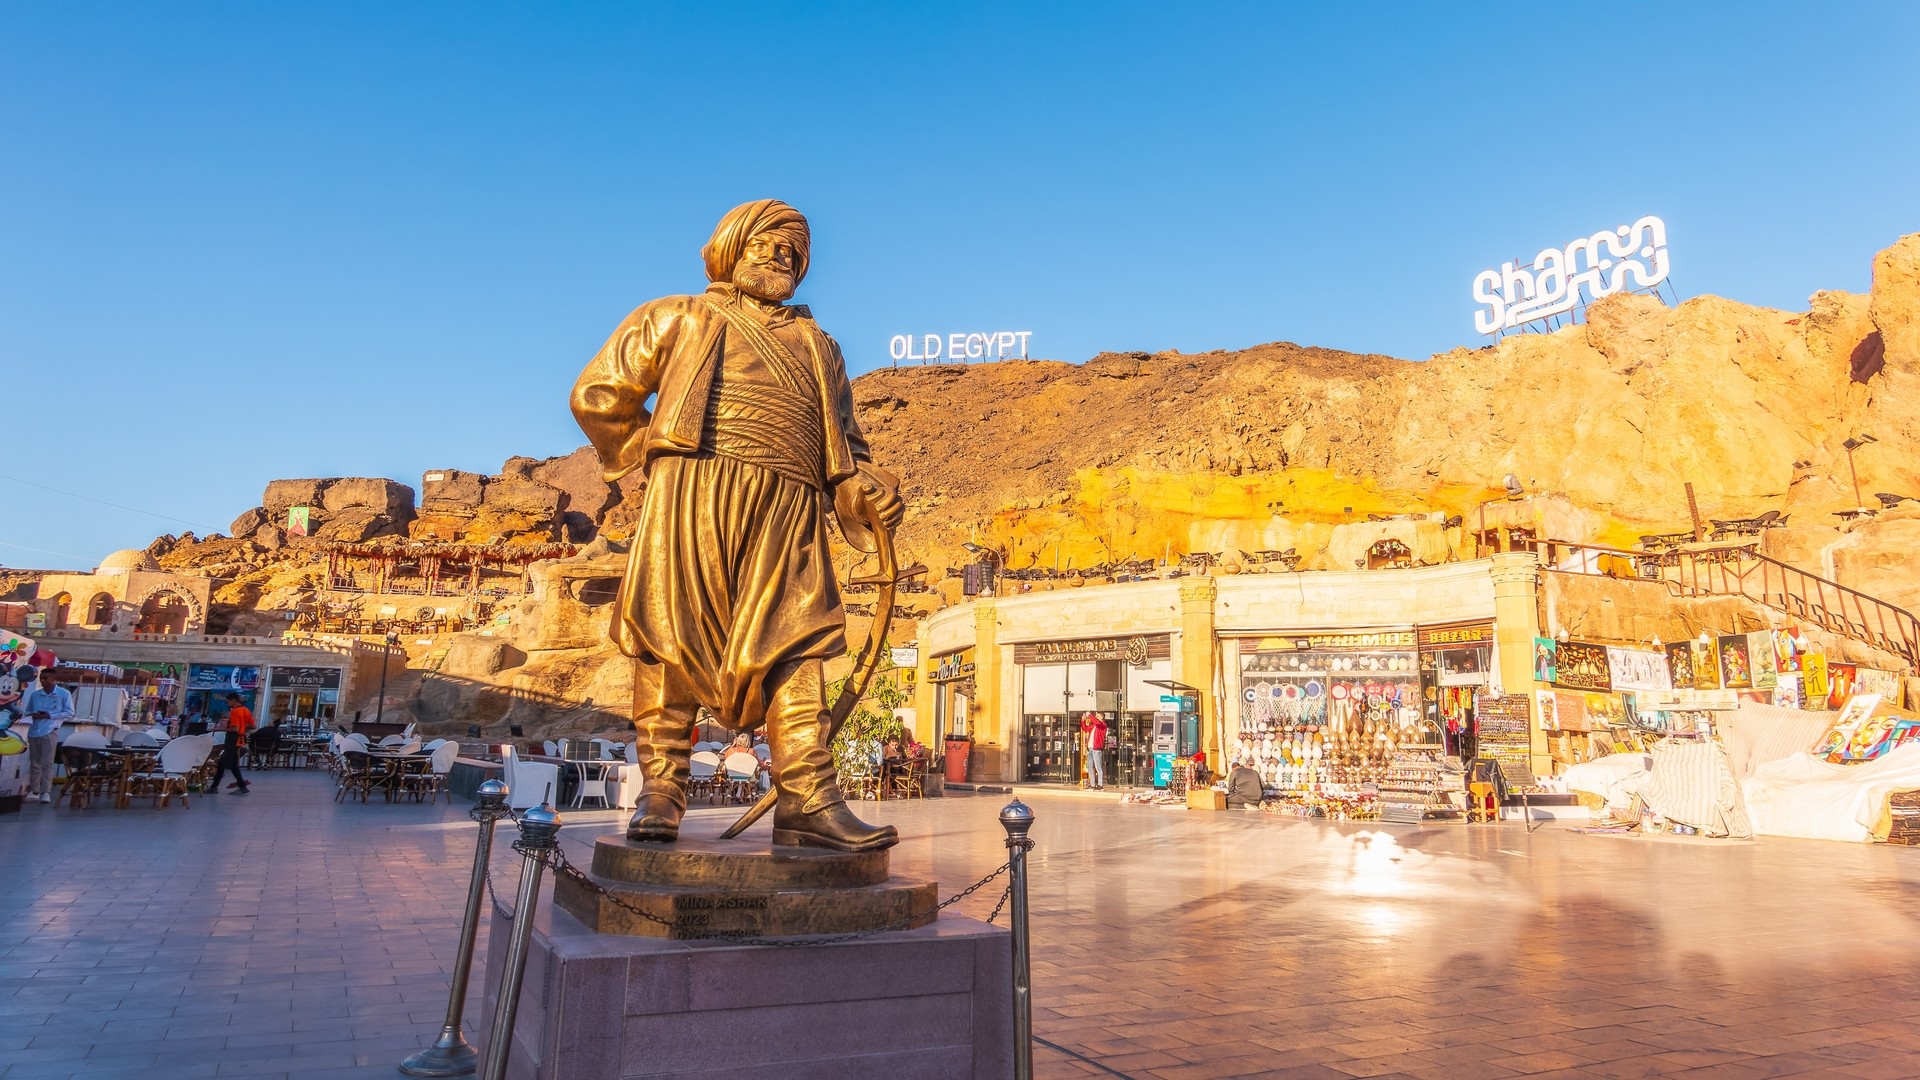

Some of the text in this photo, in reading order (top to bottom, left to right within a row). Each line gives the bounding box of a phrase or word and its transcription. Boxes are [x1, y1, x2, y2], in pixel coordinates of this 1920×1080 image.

[890, 331, 1032, 360] OLD EGYPT
[287, 675, 325, 684] Warsha
[677, 895, 768, 909] MINA ASHAK
[677, 912, 710, 925] 2023
